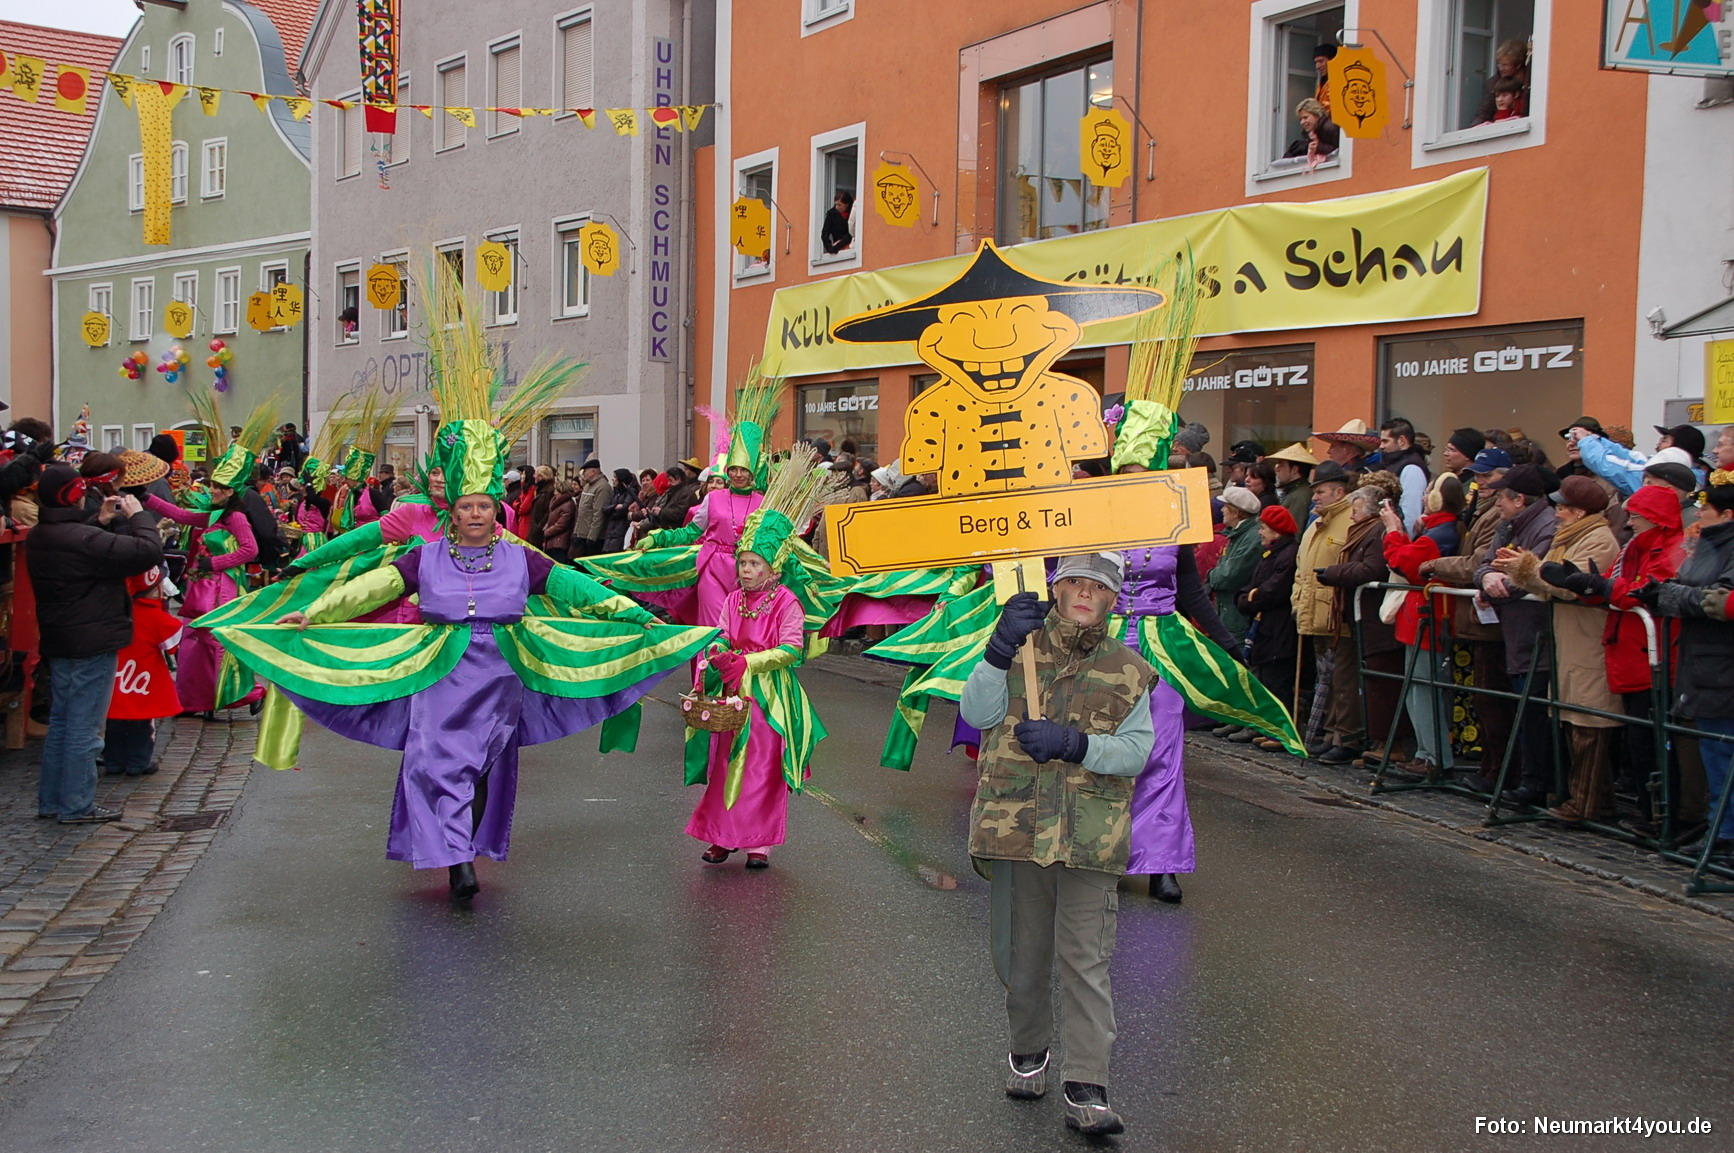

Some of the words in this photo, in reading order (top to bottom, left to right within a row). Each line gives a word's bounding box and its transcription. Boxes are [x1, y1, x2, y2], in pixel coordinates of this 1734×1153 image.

[651, 185, 670, 358] SCHMUCK
[1284, 227, 1463, 291] Schau
[382, 351, 433, 395] OPTI
[1395, 361, 1419, 378] 100
[1422, 358, 1469, 377] JAHRE
[1474, 345, 1574, 373] GÖTZ
[1182, 377, 1195, 392] 00
[1196, 375, 1231, 391] JAHRE
[1234, 365, 1309, 389] GÖTZ
[805, 402, 816, 414] 100
[817, 401, 837, 413] JAHRE
[838, 394, 879, 412] GÖTZ
[959, 515, 1009, 537] Berg
[1017, 511, 1032, 530] &
[1038, 507, 1073, 528] Tal
